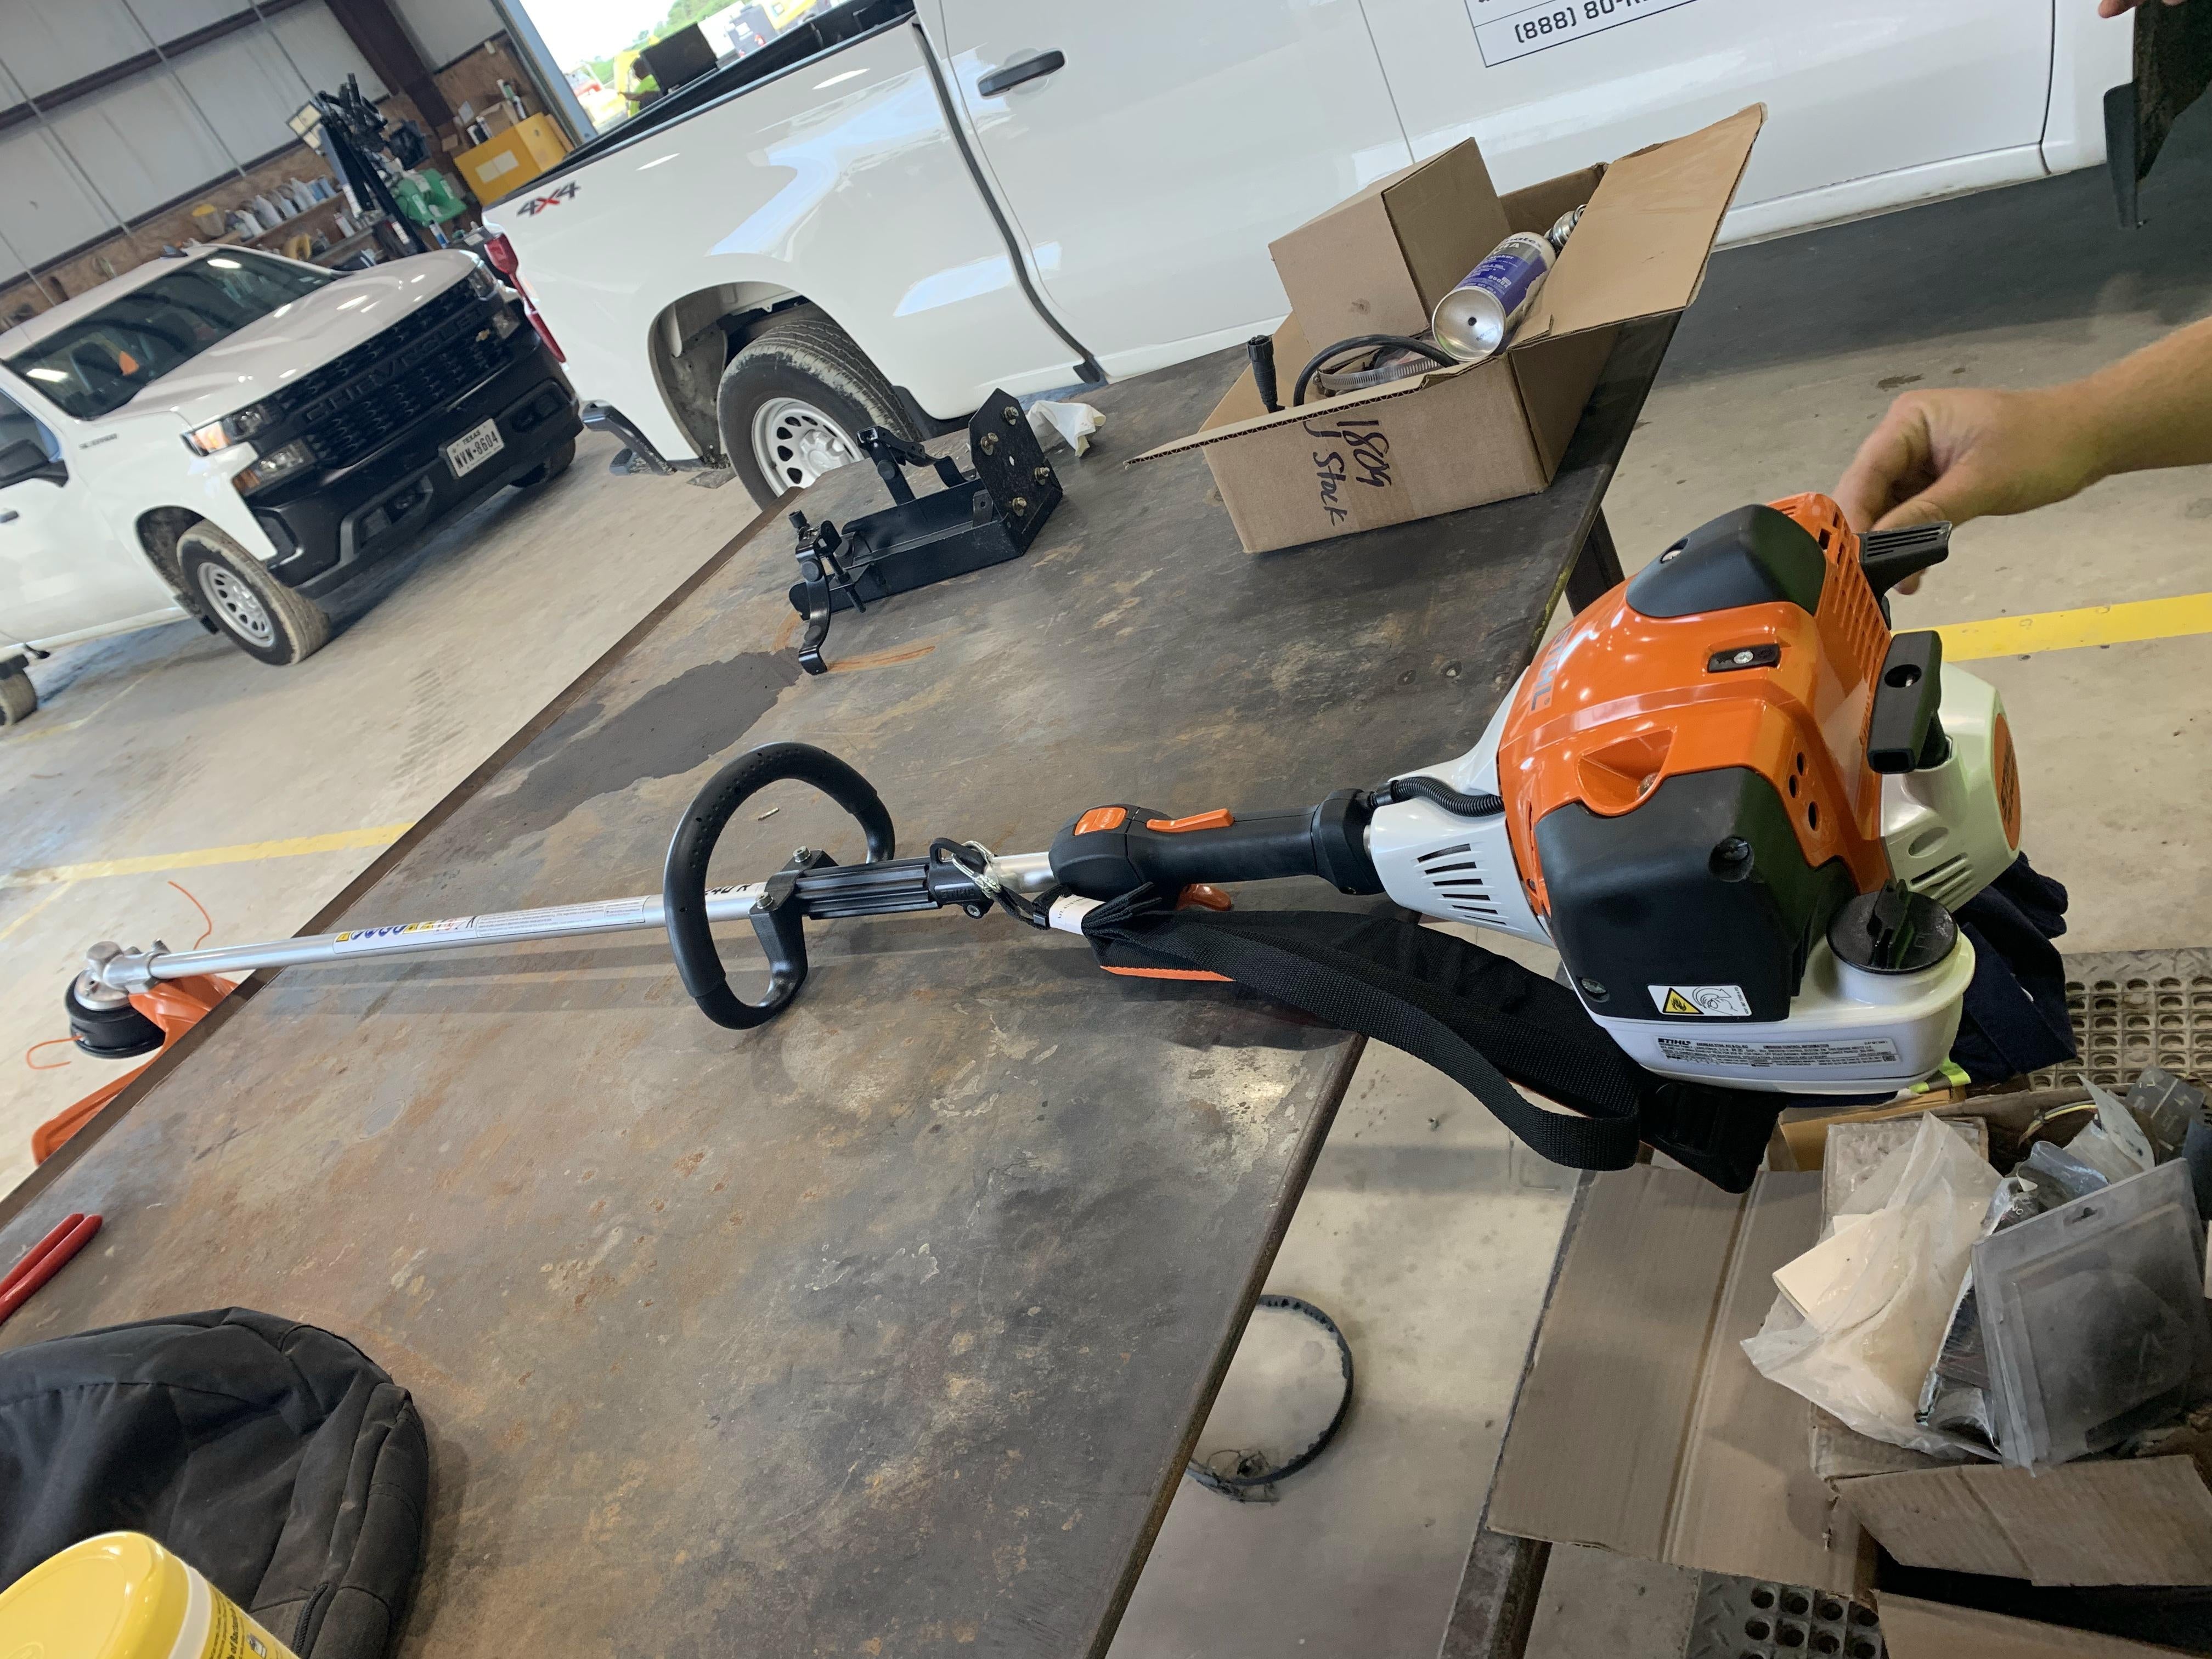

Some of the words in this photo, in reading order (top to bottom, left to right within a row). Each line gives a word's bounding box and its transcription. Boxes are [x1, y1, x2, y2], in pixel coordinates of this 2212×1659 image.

[1514, 7, 1577, 43] (888)
[462, 430, 481, 445] TEXAS
[1336, 420, 1392, 487] 1809
[1658, 1037, 1691, 1046] STIHL
